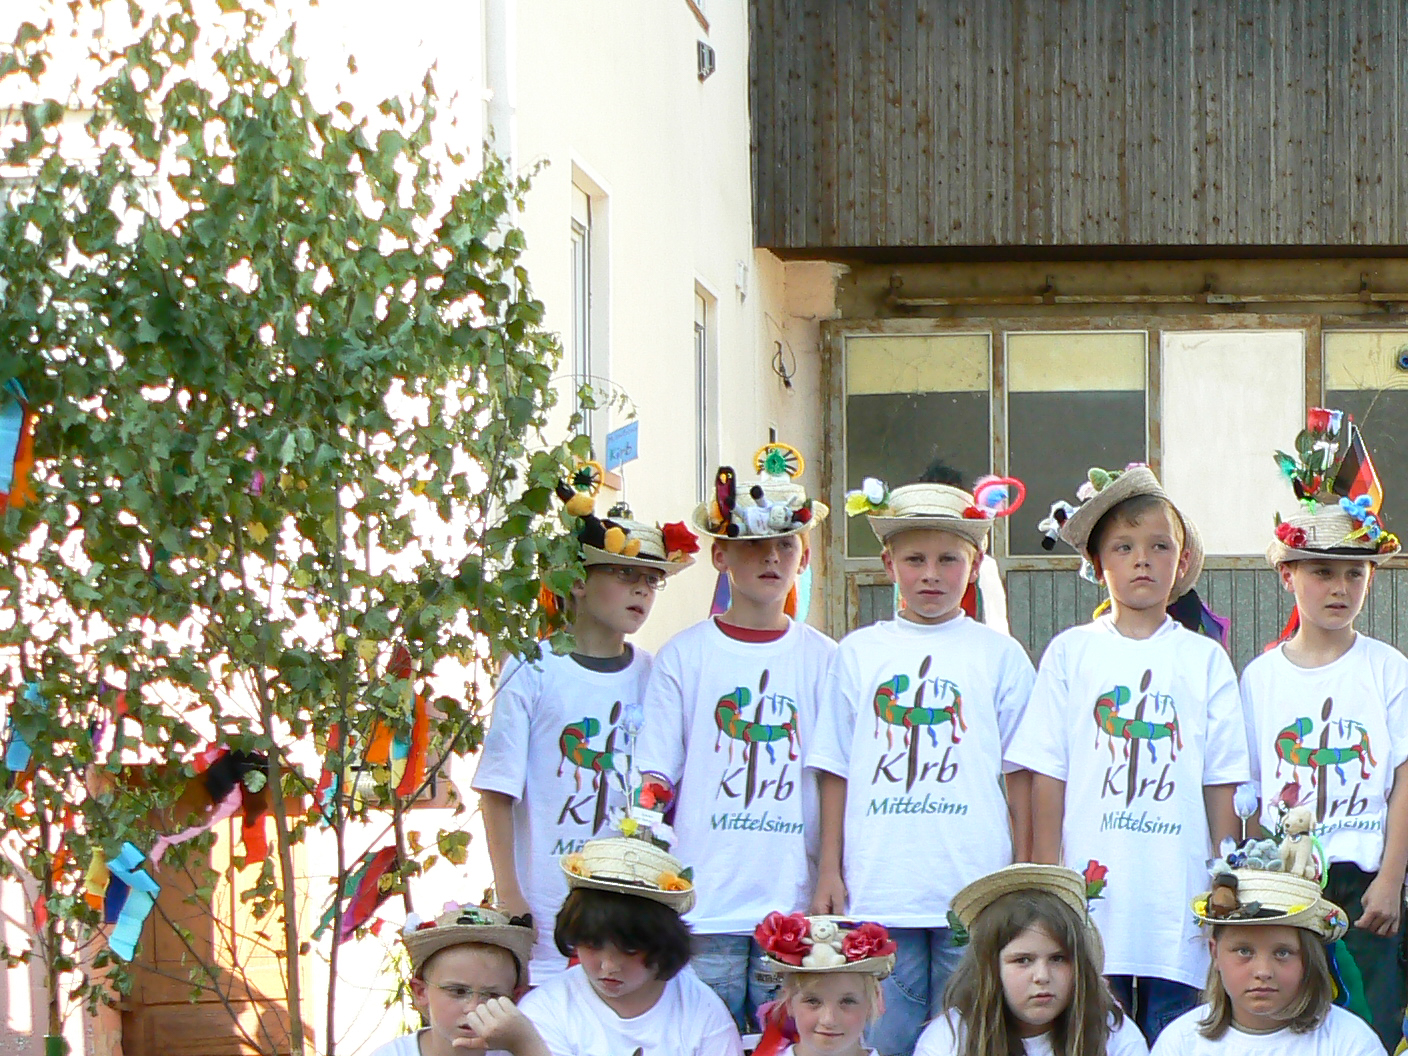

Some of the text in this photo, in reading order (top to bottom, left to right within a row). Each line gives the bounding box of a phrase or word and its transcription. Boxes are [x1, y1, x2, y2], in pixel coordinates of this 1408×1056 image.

[866, 795, 968, 816] Mittelsinn
[710, 811, 804, 835] Mittelsinn
[1100, 811, 1182, 836] Mittelsinn
